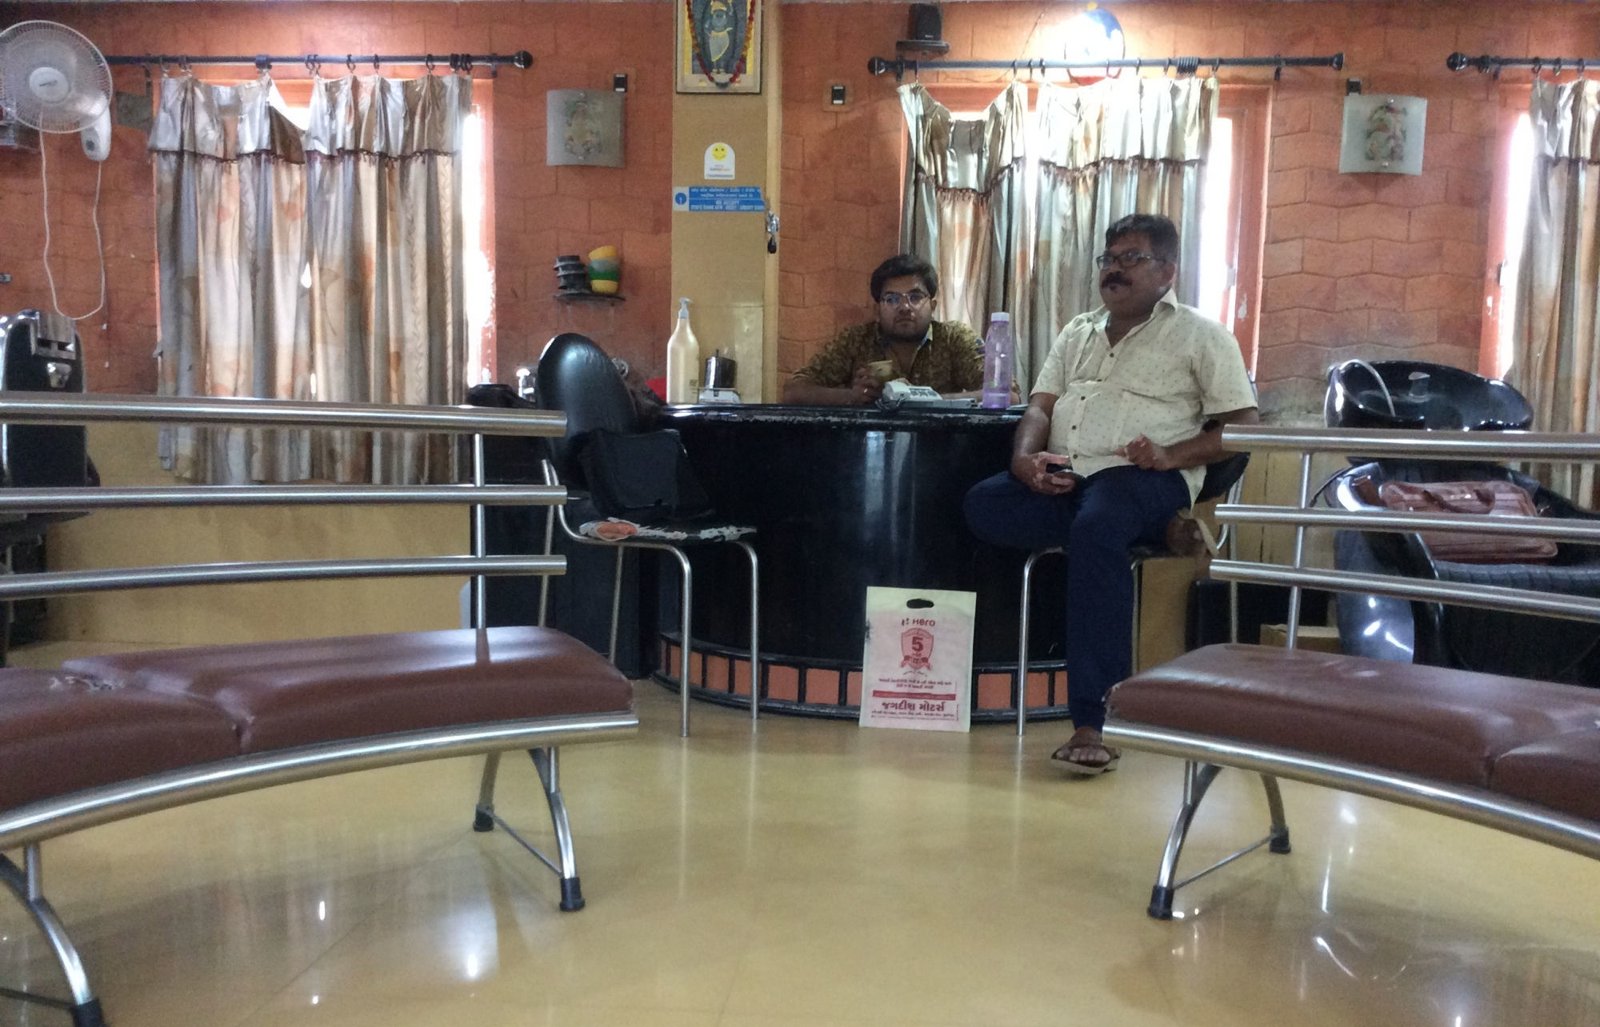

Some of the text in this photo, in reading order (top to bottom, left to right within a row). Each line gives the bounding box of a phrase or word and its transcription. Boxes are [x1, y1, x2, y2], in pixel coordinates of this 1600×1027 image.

[912, 618, 936, 627] Hero
[911, 636, 924, 652] 5
[881, 700, 915, 711] જગદીશ
